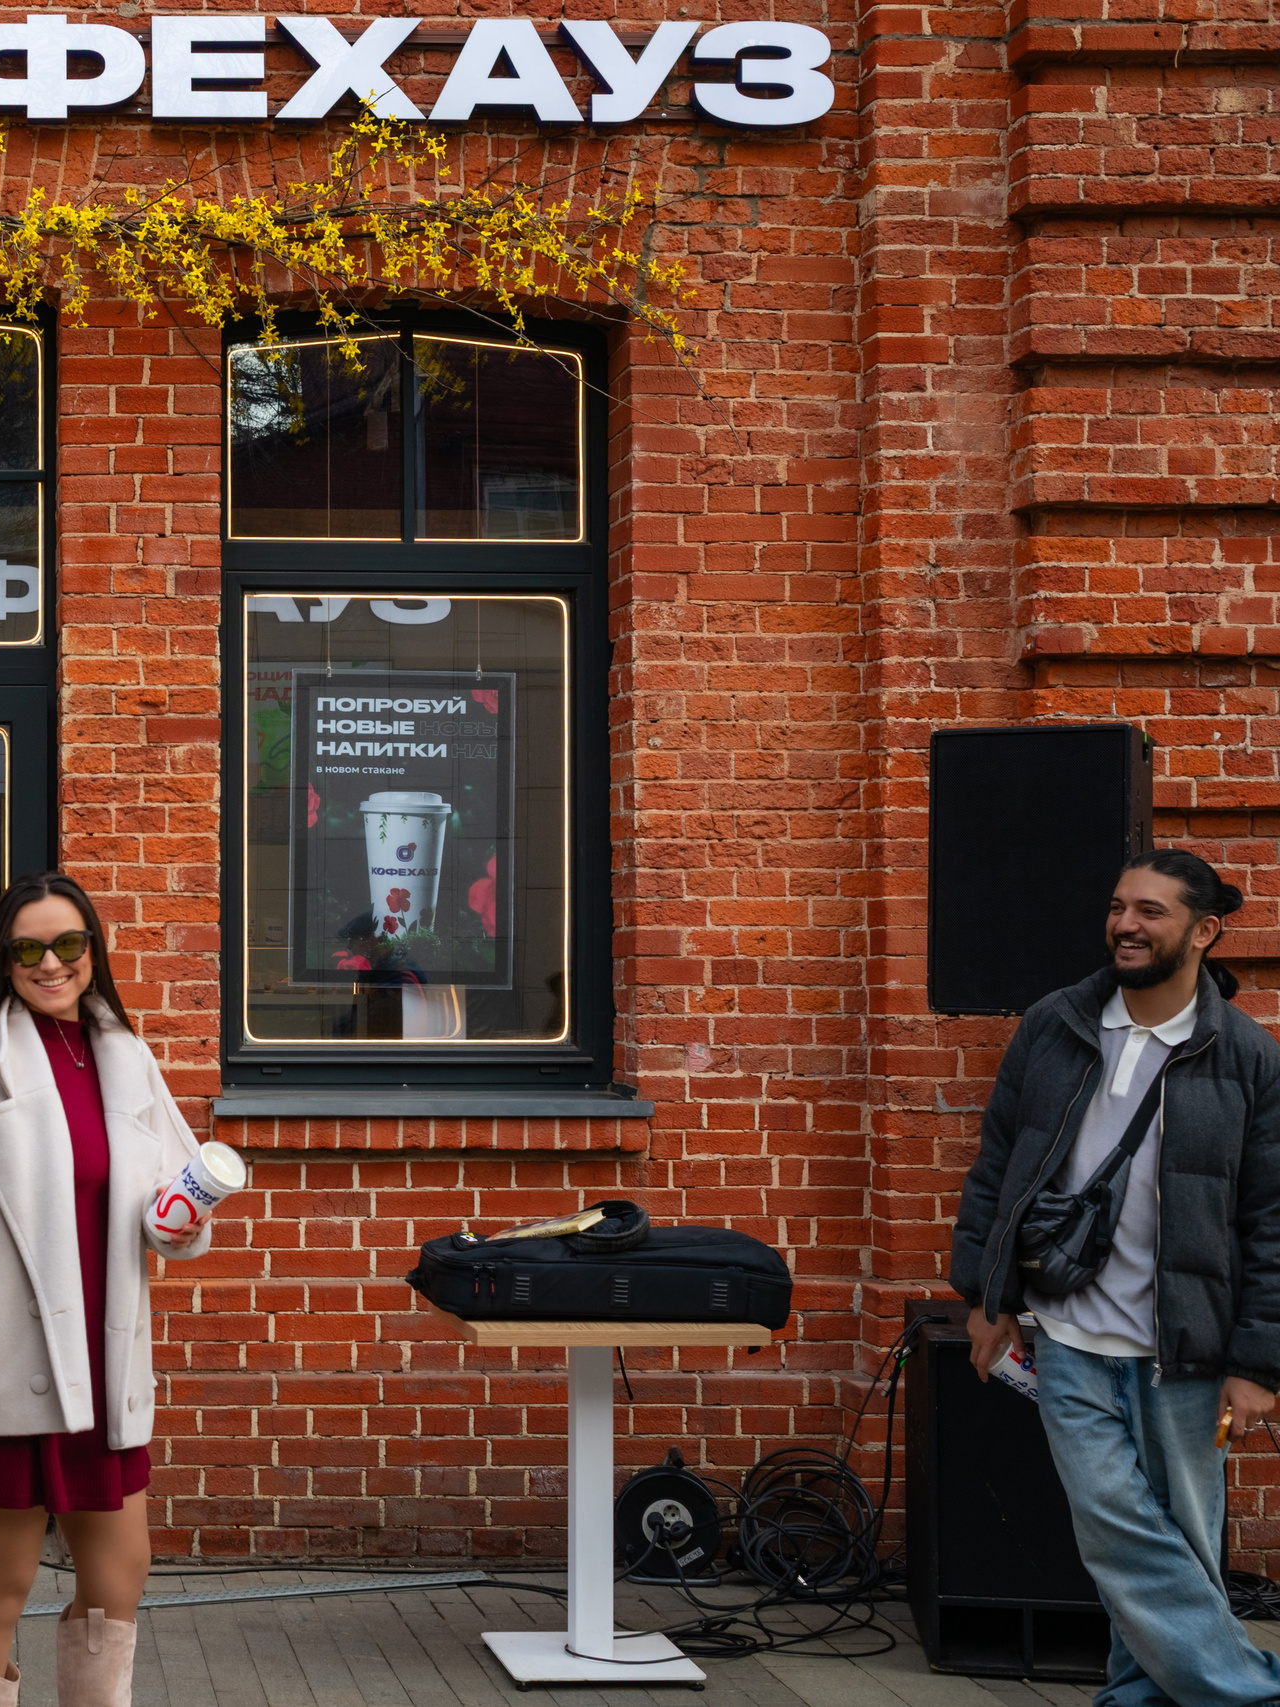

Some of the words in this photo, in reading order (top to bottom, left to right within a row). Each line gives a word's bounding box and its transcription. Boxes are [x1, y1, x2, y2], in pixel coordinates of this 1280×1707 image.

[317, 697, 466, 714] ПОПРОБУЙ
[317, 719, 415, 736] НОВЫЕ
[317, 742, 447, 758] НАПИТКИ
[325, 766, 360, 774] новом
[361, 767, 405, 775] стакане
